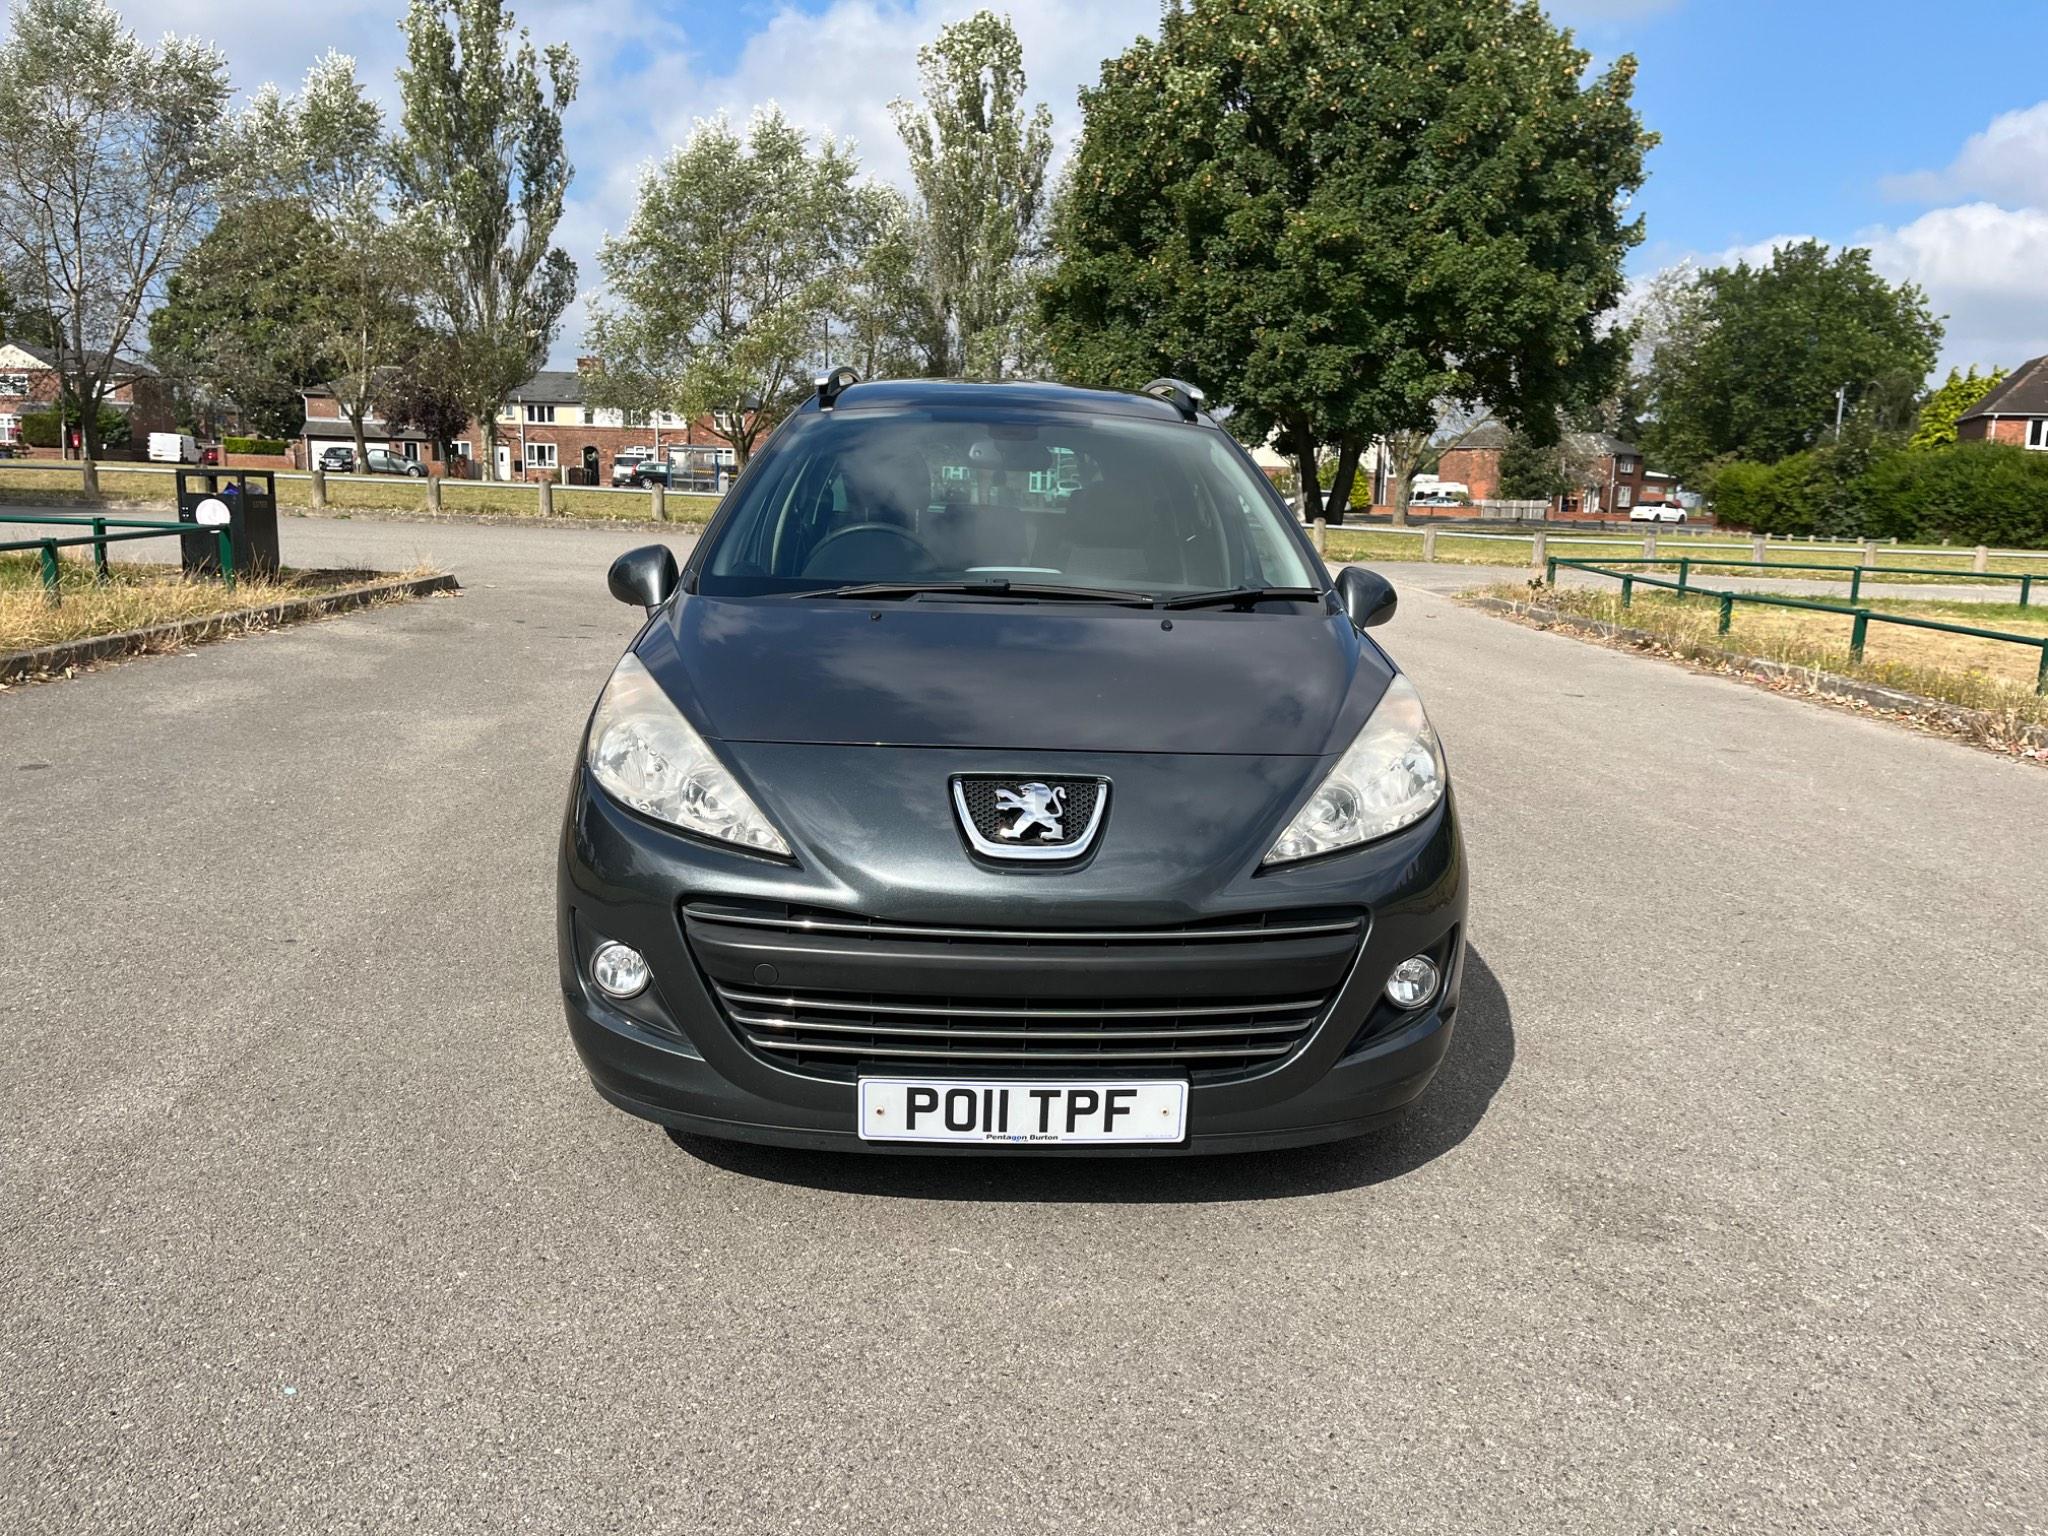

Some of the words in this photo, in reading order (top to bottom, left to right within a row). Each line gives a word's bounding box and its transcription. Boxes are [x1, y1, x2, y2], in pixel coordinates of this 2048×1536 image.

[1029, 1089, 1138, 1133] TPF
[986, 1133, 1028, 1142] Pentagon
[1029, 1133, 1059, 1141] Burton
